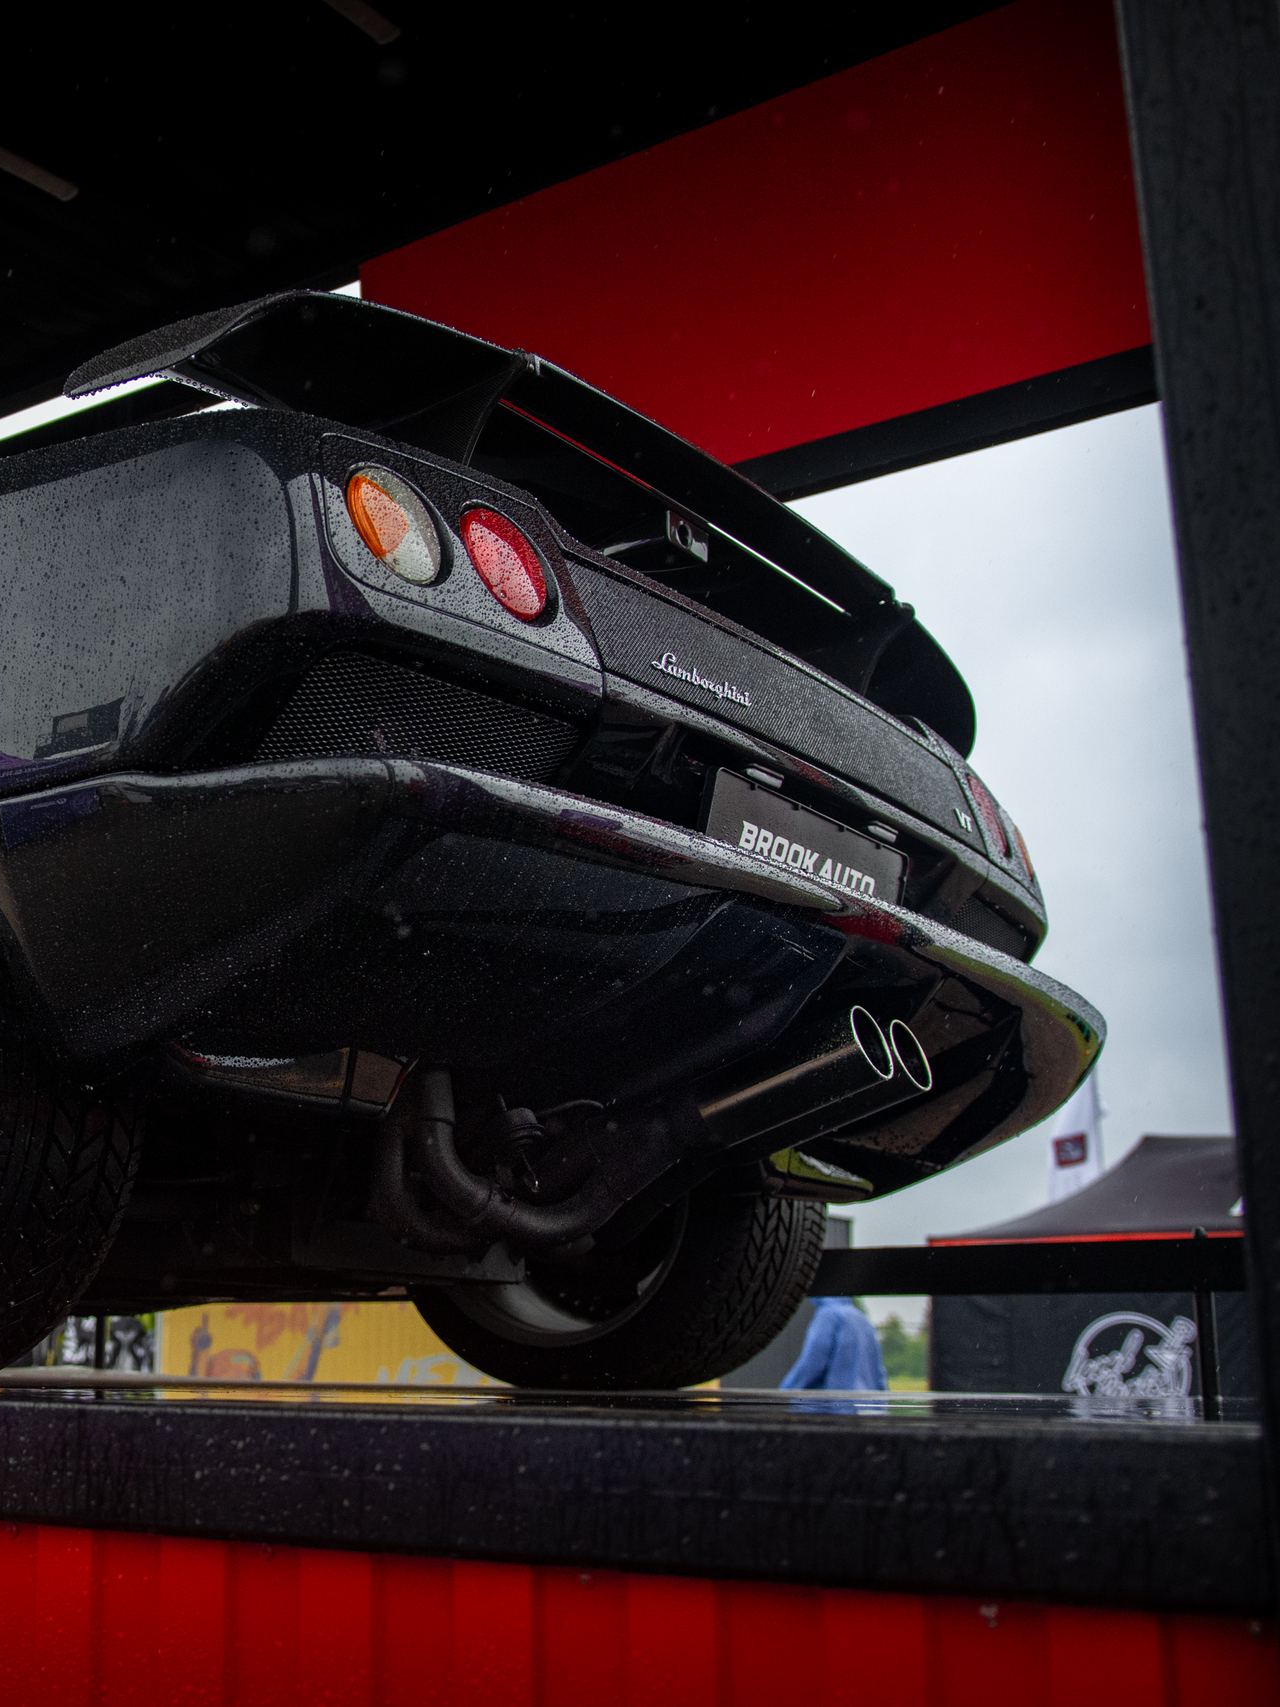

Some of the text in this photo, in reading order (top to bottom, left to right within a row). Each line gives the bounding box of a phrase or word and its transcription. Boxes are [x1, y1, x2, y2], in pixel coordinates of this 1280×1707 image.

[650, 652, 753, 707] Lamborghini
[954, 807, 973, 833] VT
[738, 820, 876, 895] BROOK AUTO
